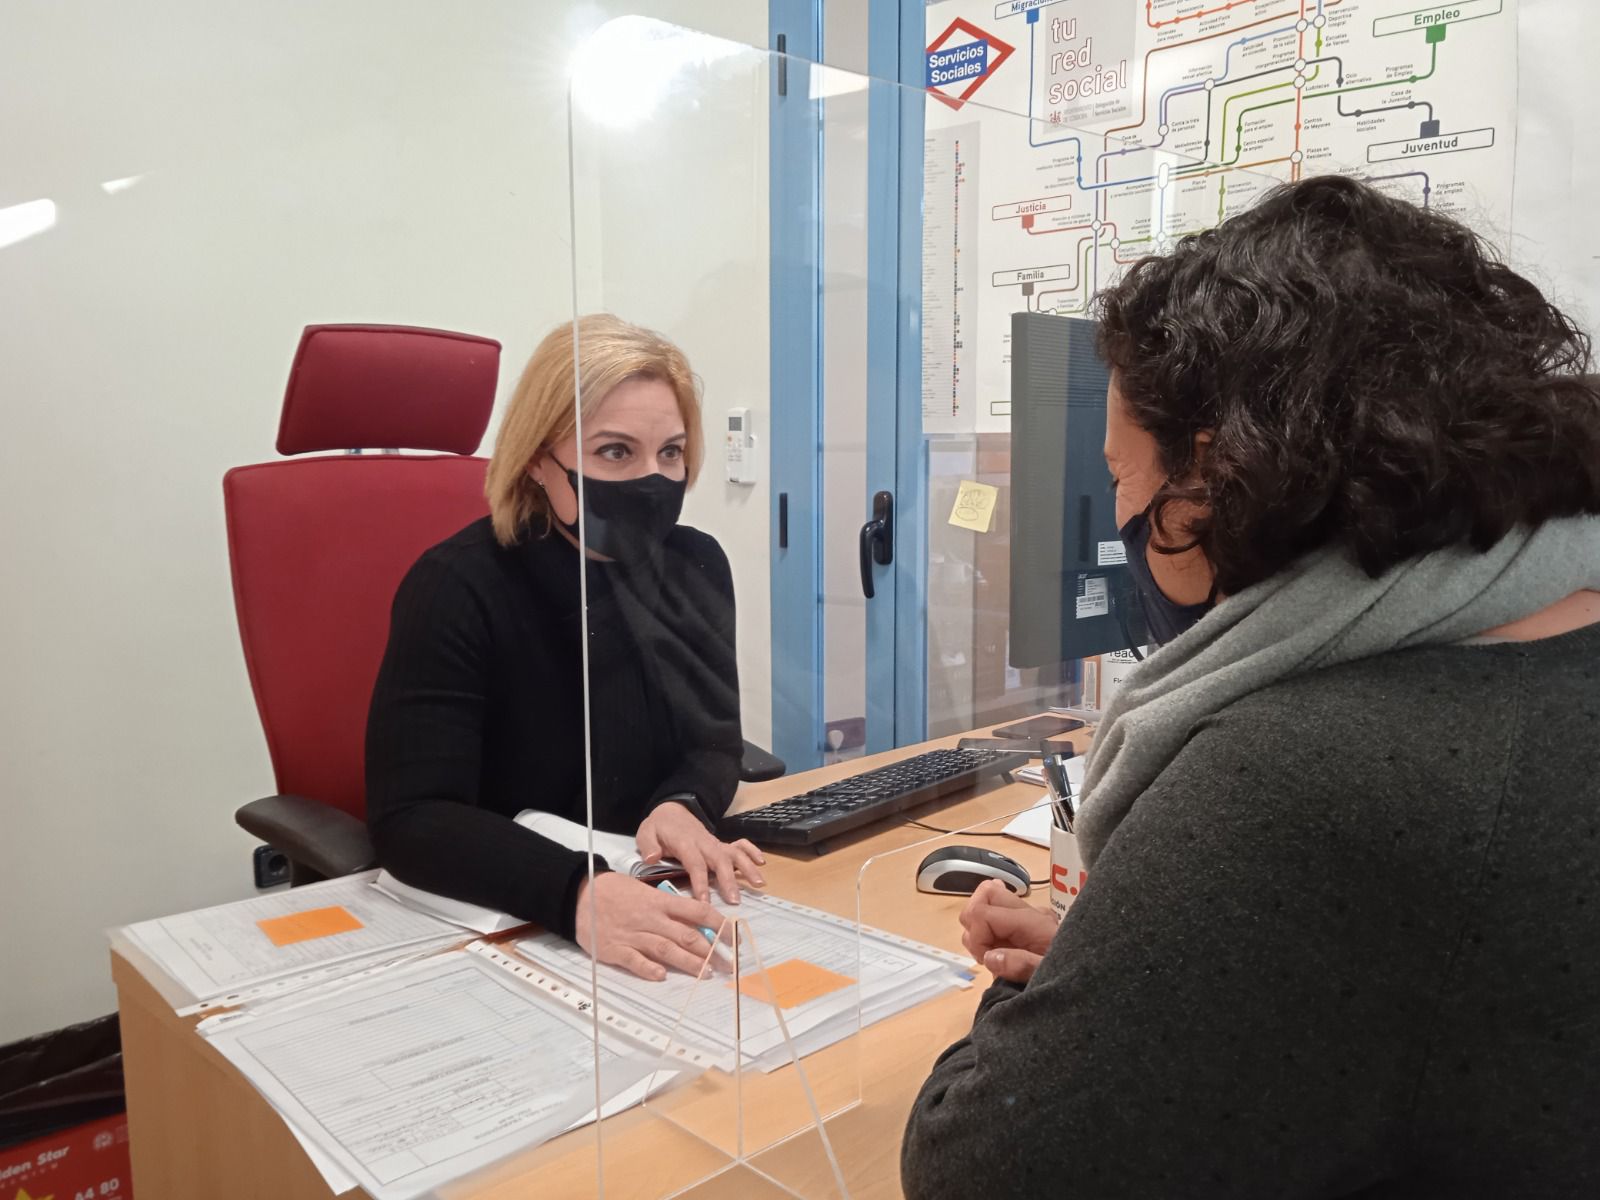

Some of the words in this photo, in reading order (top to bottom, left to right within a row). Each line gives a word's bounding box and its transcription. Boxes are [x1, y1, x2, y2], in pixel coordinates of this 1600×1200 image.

[1011, 0, 1051, 12] Migraci
[1414, 10, 1460, 25] Empleo
[1051, 17, 1077, 44] tu
[929, 46, 984, 68] Servicios
[1051, 37, 1092, 75] red
[931, 62, 981, 83] Sociales
[1049, 60, 1127, 105] social
[1402, 137, 1458, 154] Juventud
[1016, 202, 1046, 214] Justicia
[1017, 270, 1044, 280] Familia
[37, 1146, 70, 1165] Star
